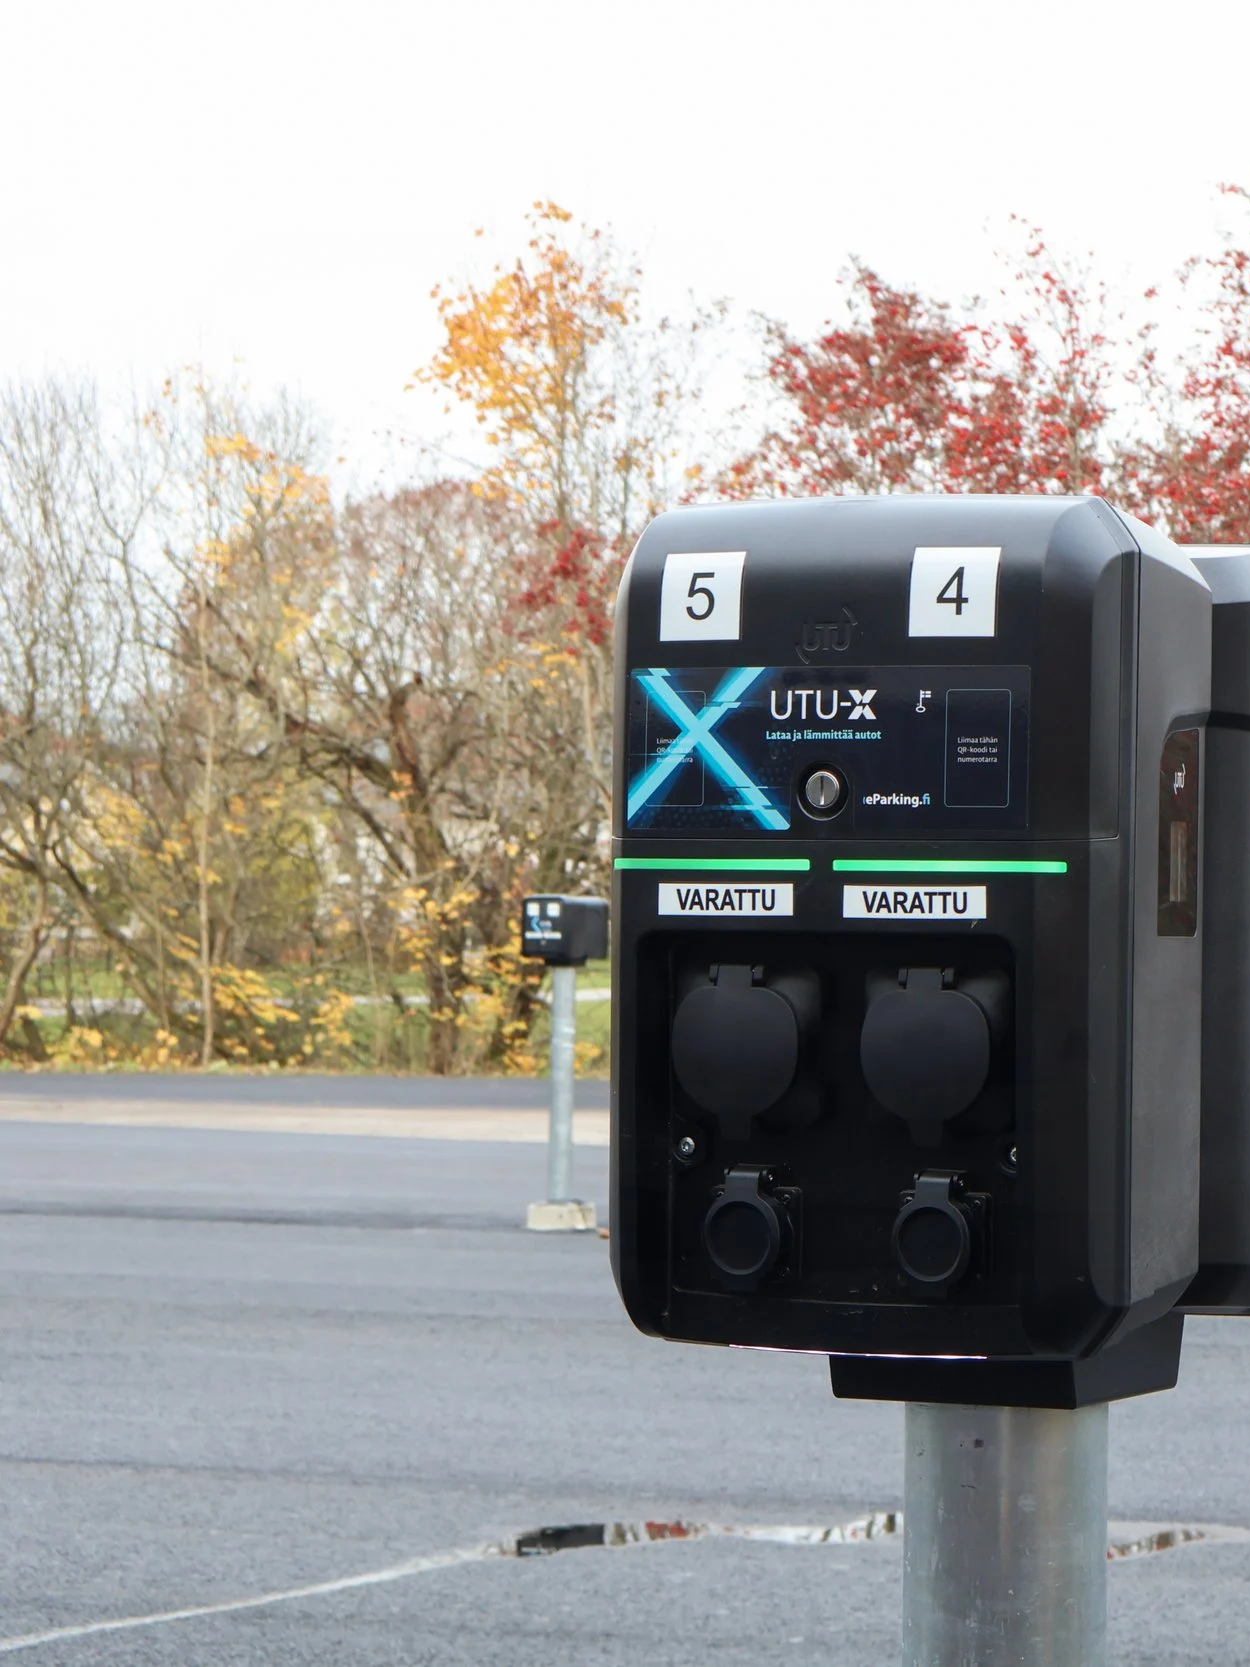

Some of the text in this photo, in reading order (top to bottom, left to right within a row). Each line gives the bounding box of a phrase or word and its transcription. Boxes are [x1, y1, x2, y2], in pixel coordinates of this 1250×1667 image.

[686, 572, 715, 620] 5
[936, 566, 969, 616] 4
[802, 621, 851, 651] UTU
[770, 689, 878, 720] UTU-X
[766, 729, 882, 742] Lataa ja lämmittää autot
[979, 736, 999, 744] tähän
[957, 746, 988, 755] QR-koodi
[865, 793, 931, 808] eParking.fi
[676, 888, 776, 911] VARATTU
[862, 891, 968, 914] VARATTU
